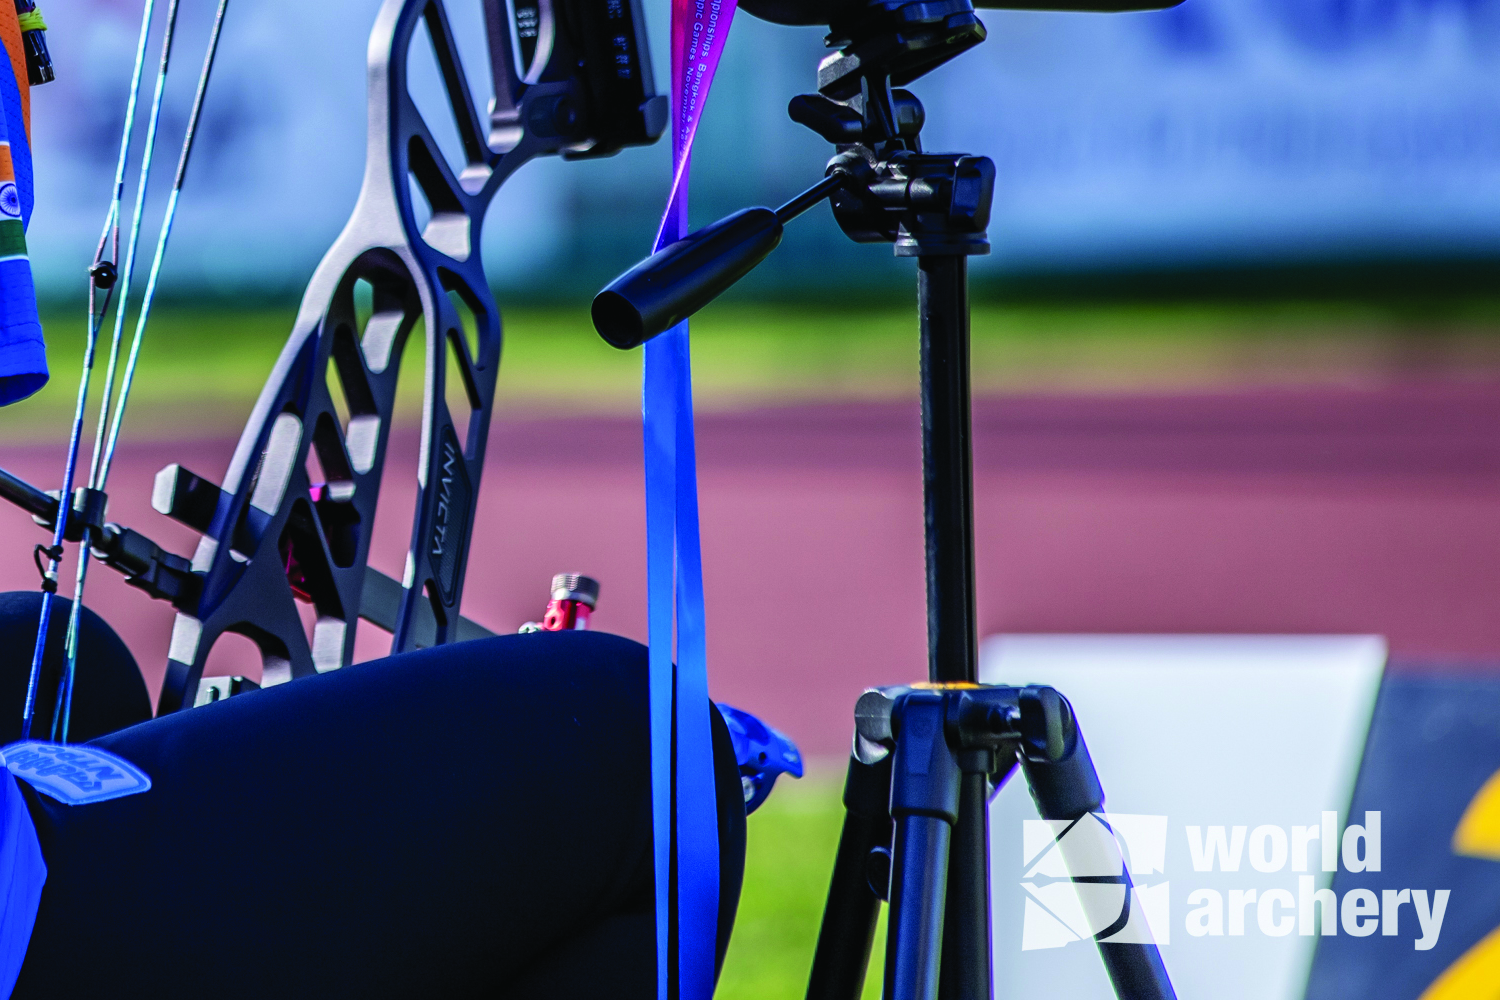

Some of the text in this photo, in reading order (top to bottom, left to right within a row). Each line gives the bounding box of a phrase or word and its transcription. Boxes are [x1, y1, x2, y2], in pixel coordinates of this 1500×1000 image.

[680, 66, 694, 123] November
[689, 63, 707, 111] Bangkok
[432, 443, 455, 554] INVICTA
